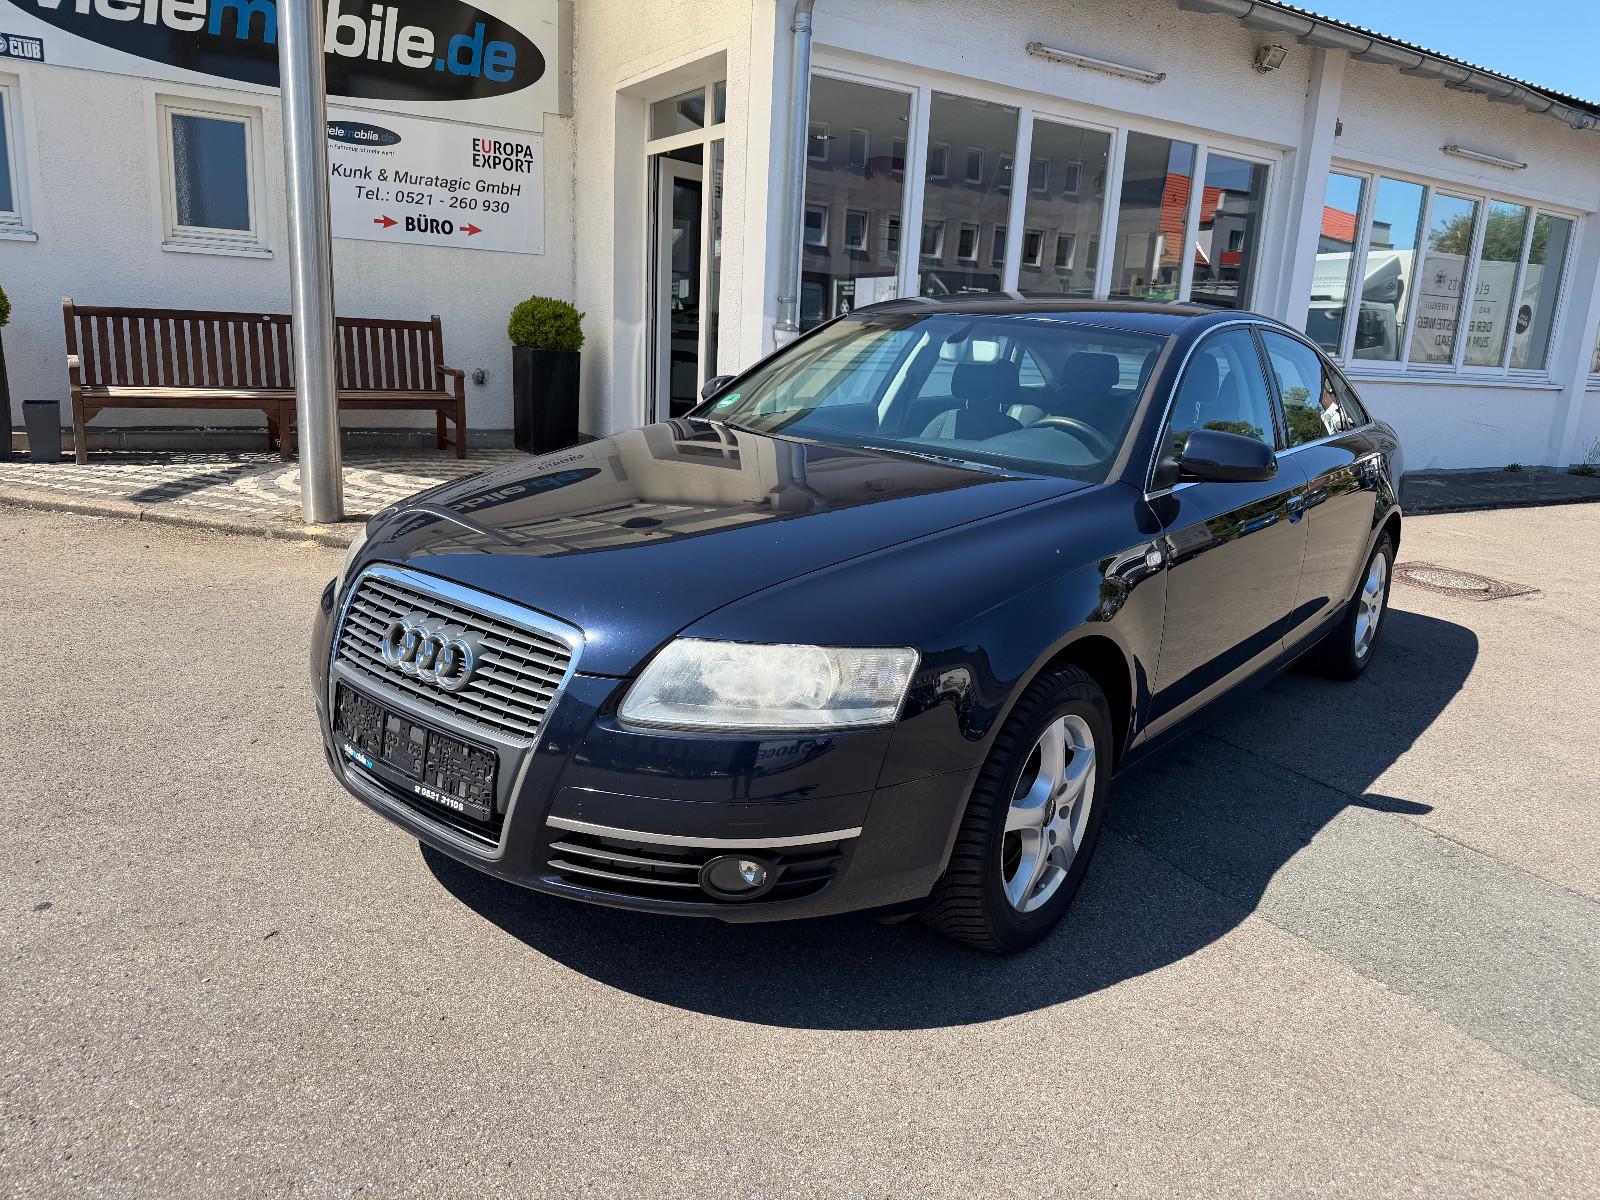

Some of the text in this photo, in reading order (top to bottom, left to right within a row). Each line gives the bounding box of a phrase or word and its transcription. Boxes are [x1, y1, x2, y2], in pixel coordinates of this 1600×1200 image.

[9, 40, 41, 58] CLUB
[327, 125, 395, 142] ielemobile.de
[472, 138, 534, 159] EUROPA
[472, 154, 534, 174] EXPORT
[331, 163, 521, 197] Kunk & Muratagic GmbH
[355, 185, 390, 202] Tel.:
[395, 190, 433, 206] 0521
[449, 196, 478, 210] 260
[482, 199, 510, 214] 930
[405, 214, 454, 235] BÜRO
[421, 787, 439, 801] 0521
